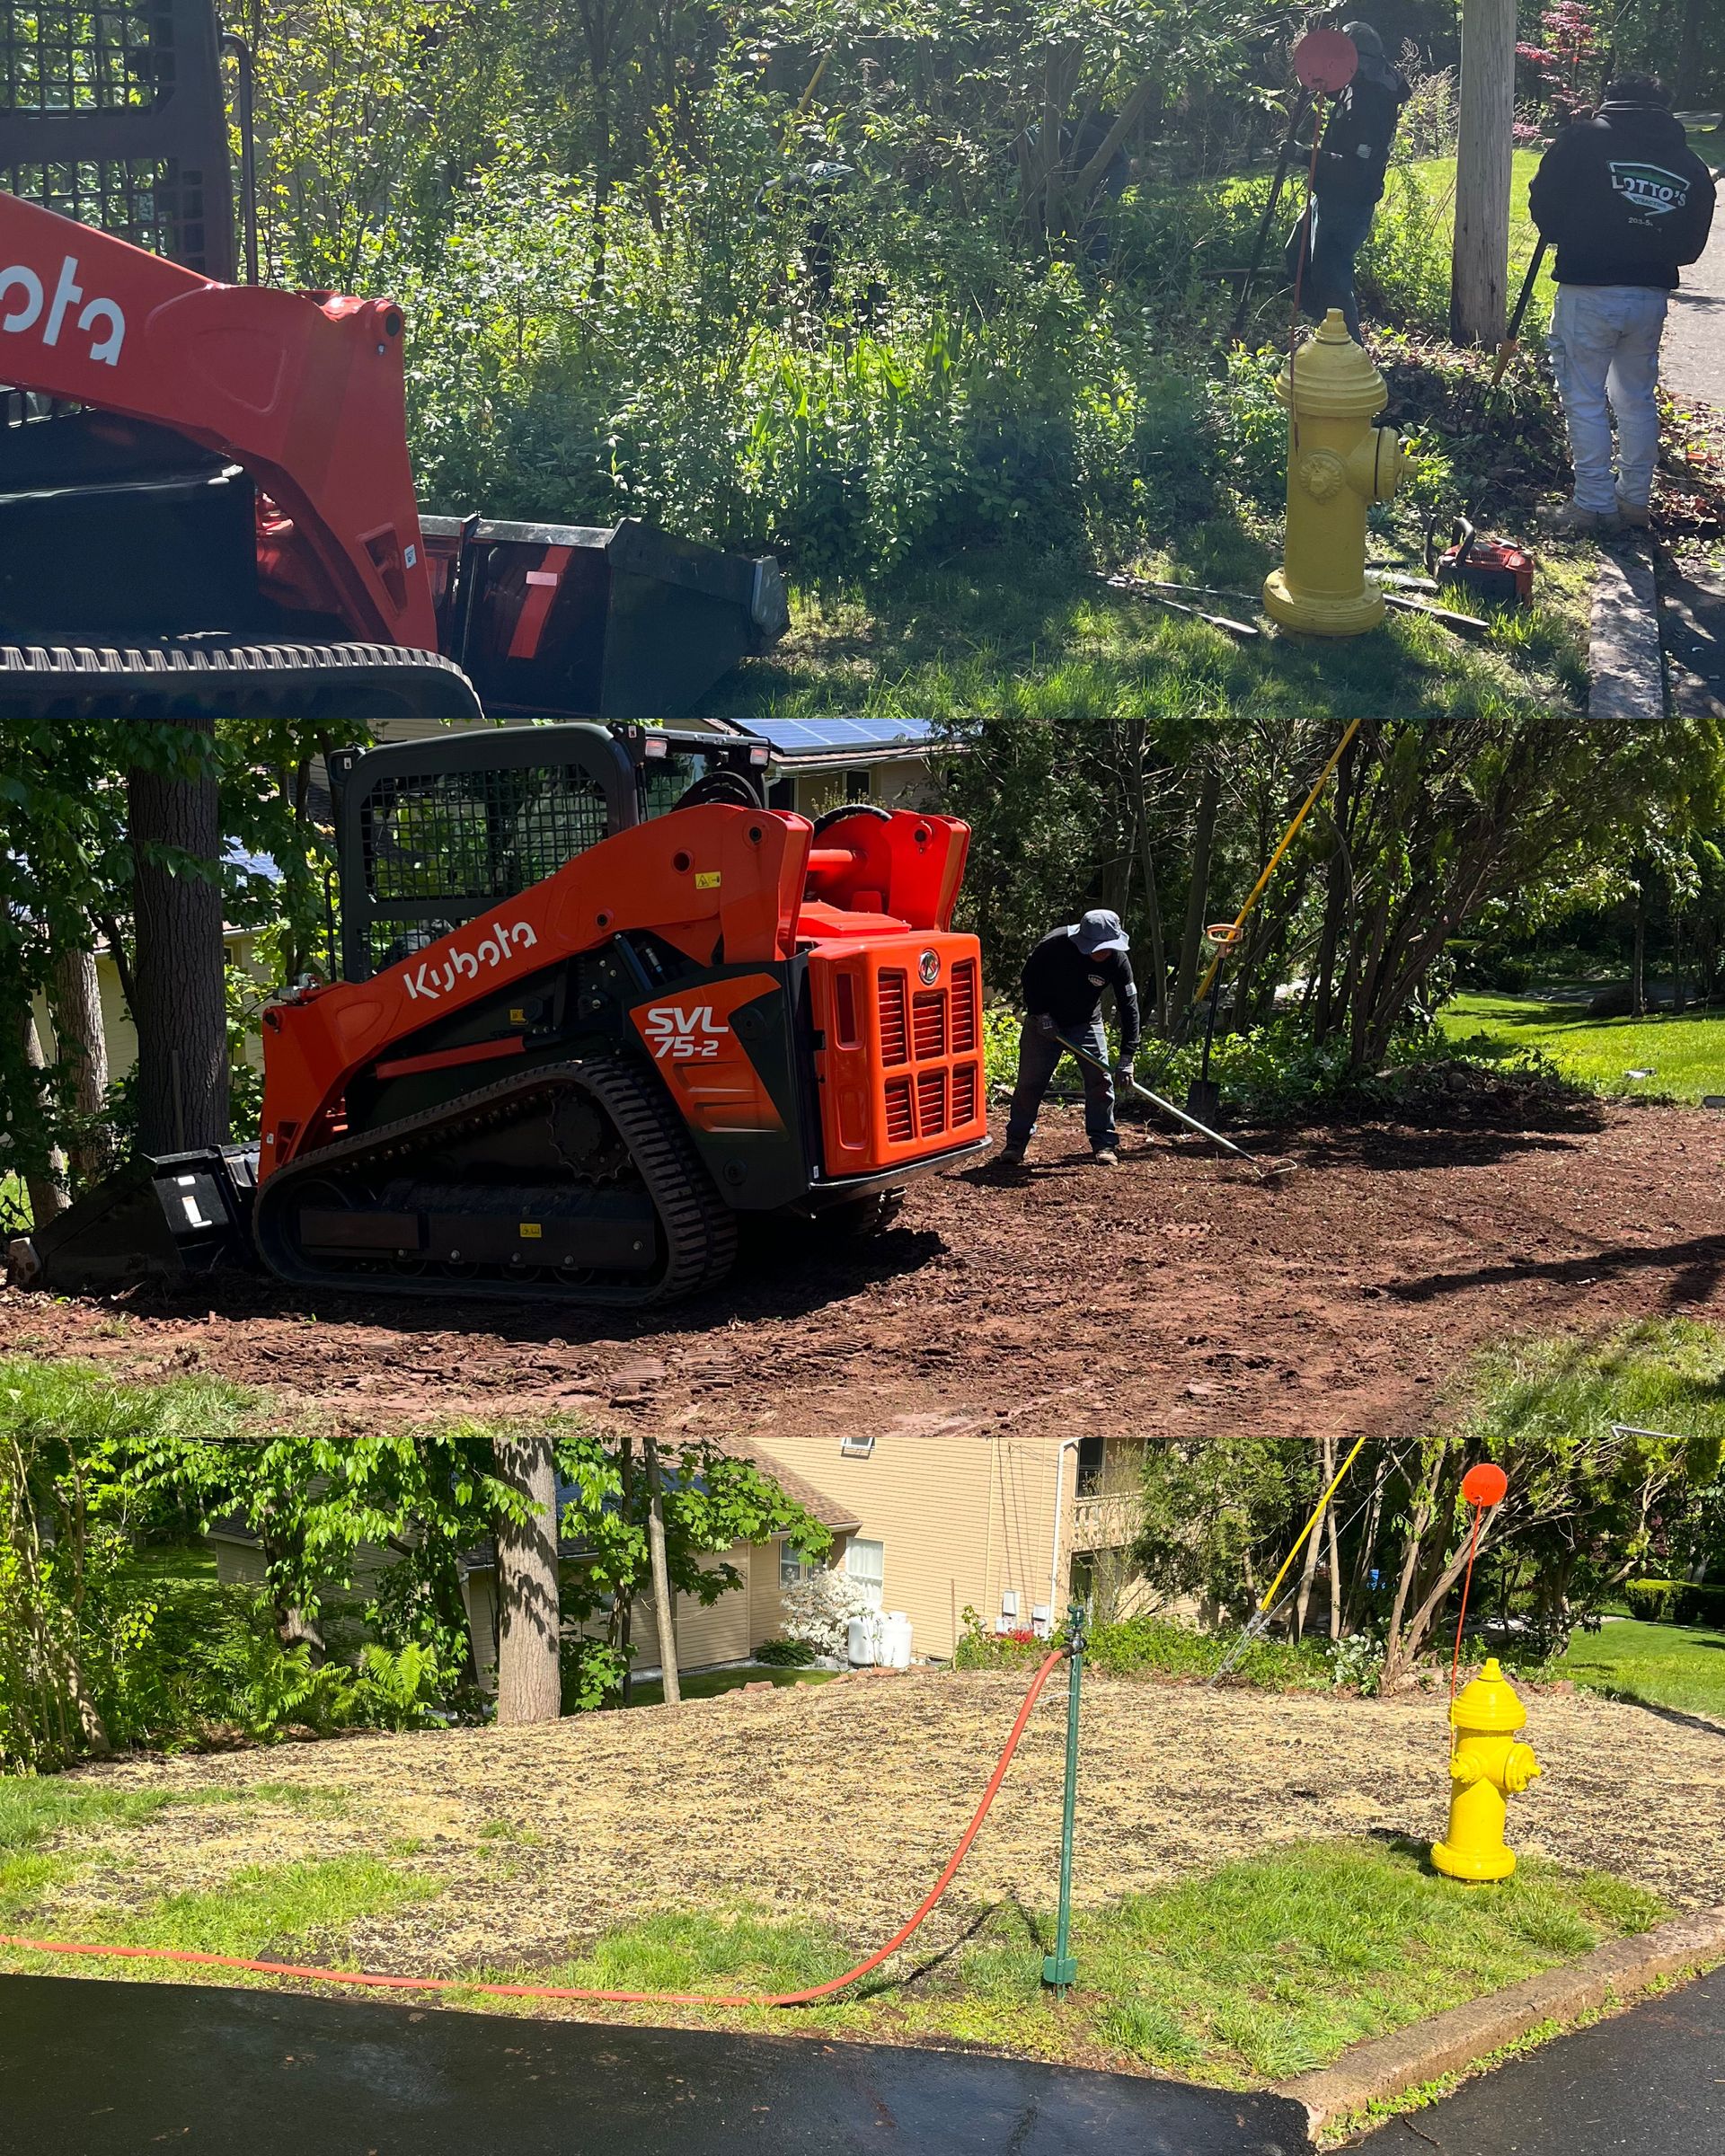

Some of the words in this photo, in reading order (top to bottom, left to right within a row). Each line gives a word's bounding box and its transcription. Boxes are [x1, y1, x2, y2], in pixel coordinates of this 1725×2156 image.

[1611, 175, 1686, 207] LOTTO'S
[403, 922, 538, 1000] Kubota
[645, 1006, 729, 1035] SVL
[654, 1036, 719, 1057] 75-2
